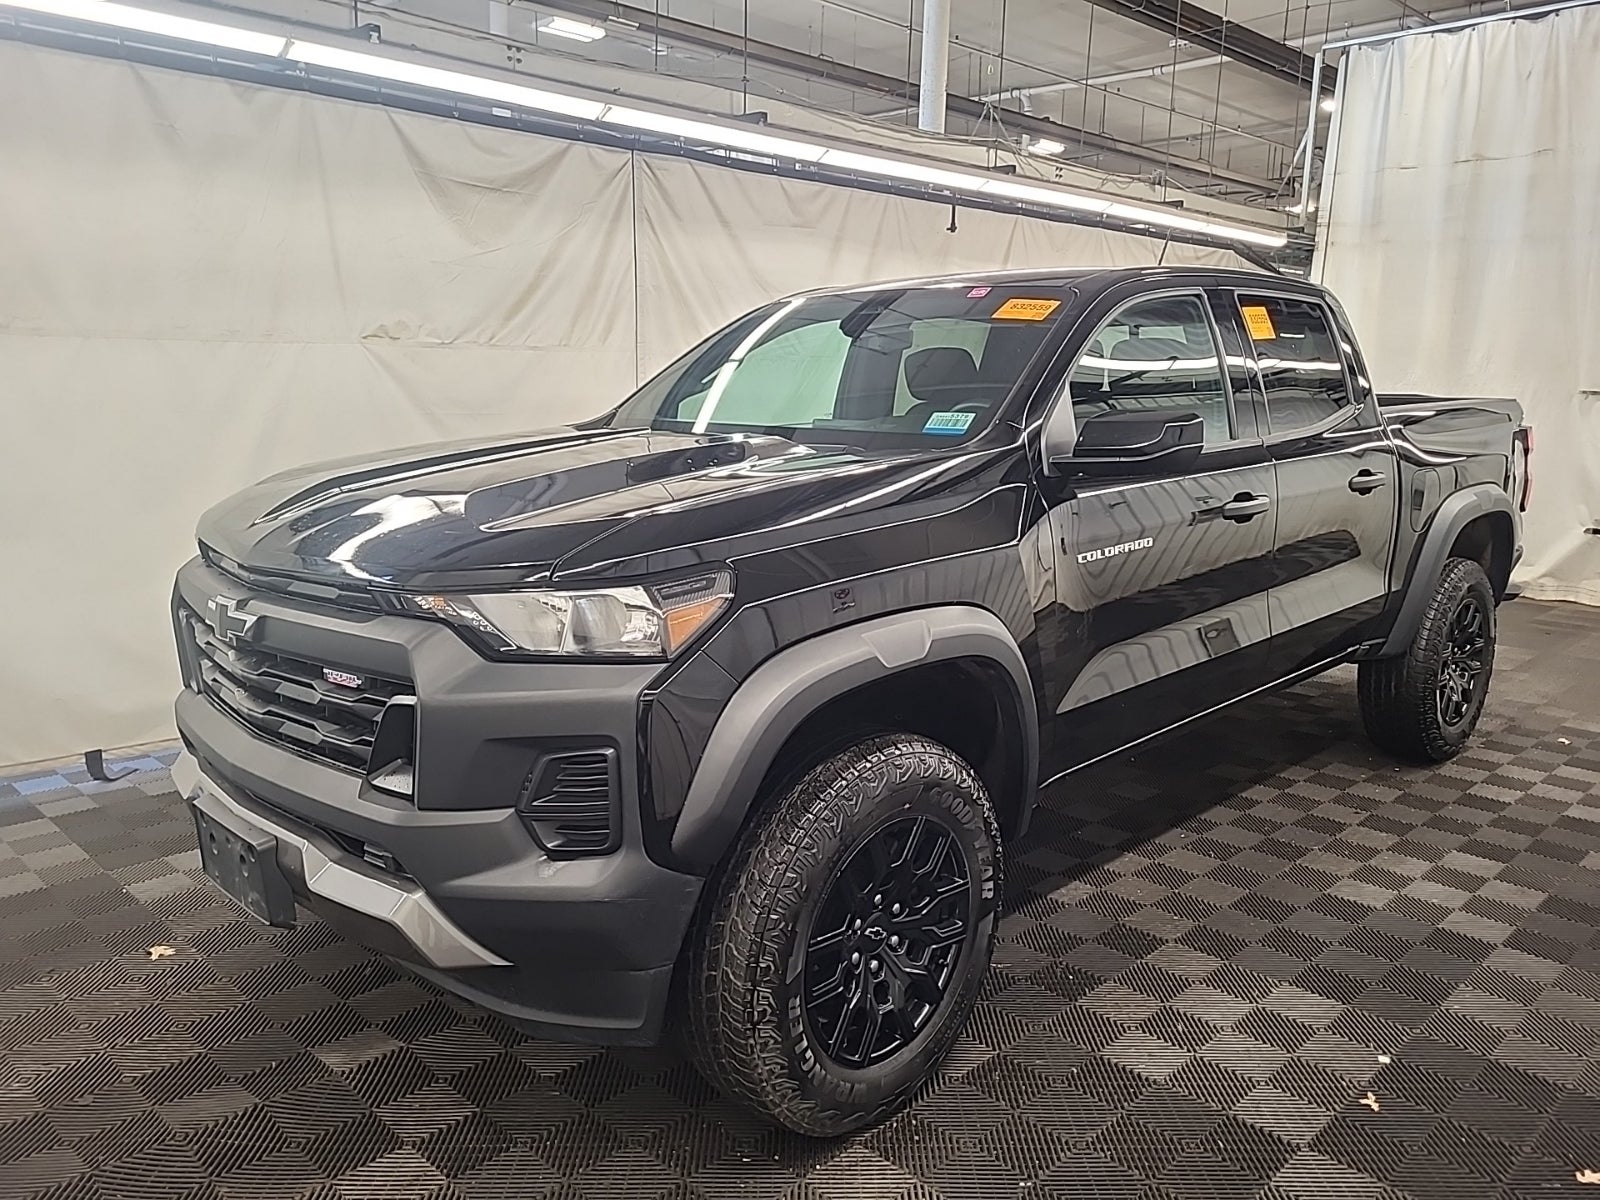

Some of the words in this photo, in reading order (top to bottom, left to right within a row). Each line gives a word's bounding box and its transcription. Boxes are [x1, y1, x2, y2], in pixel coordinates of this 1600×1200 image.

[1010, 303, 1052, 312] 832559
[1076, 537, 1154, 564] COLORADO
[788, 994, 868, 1103] WRANGLER
